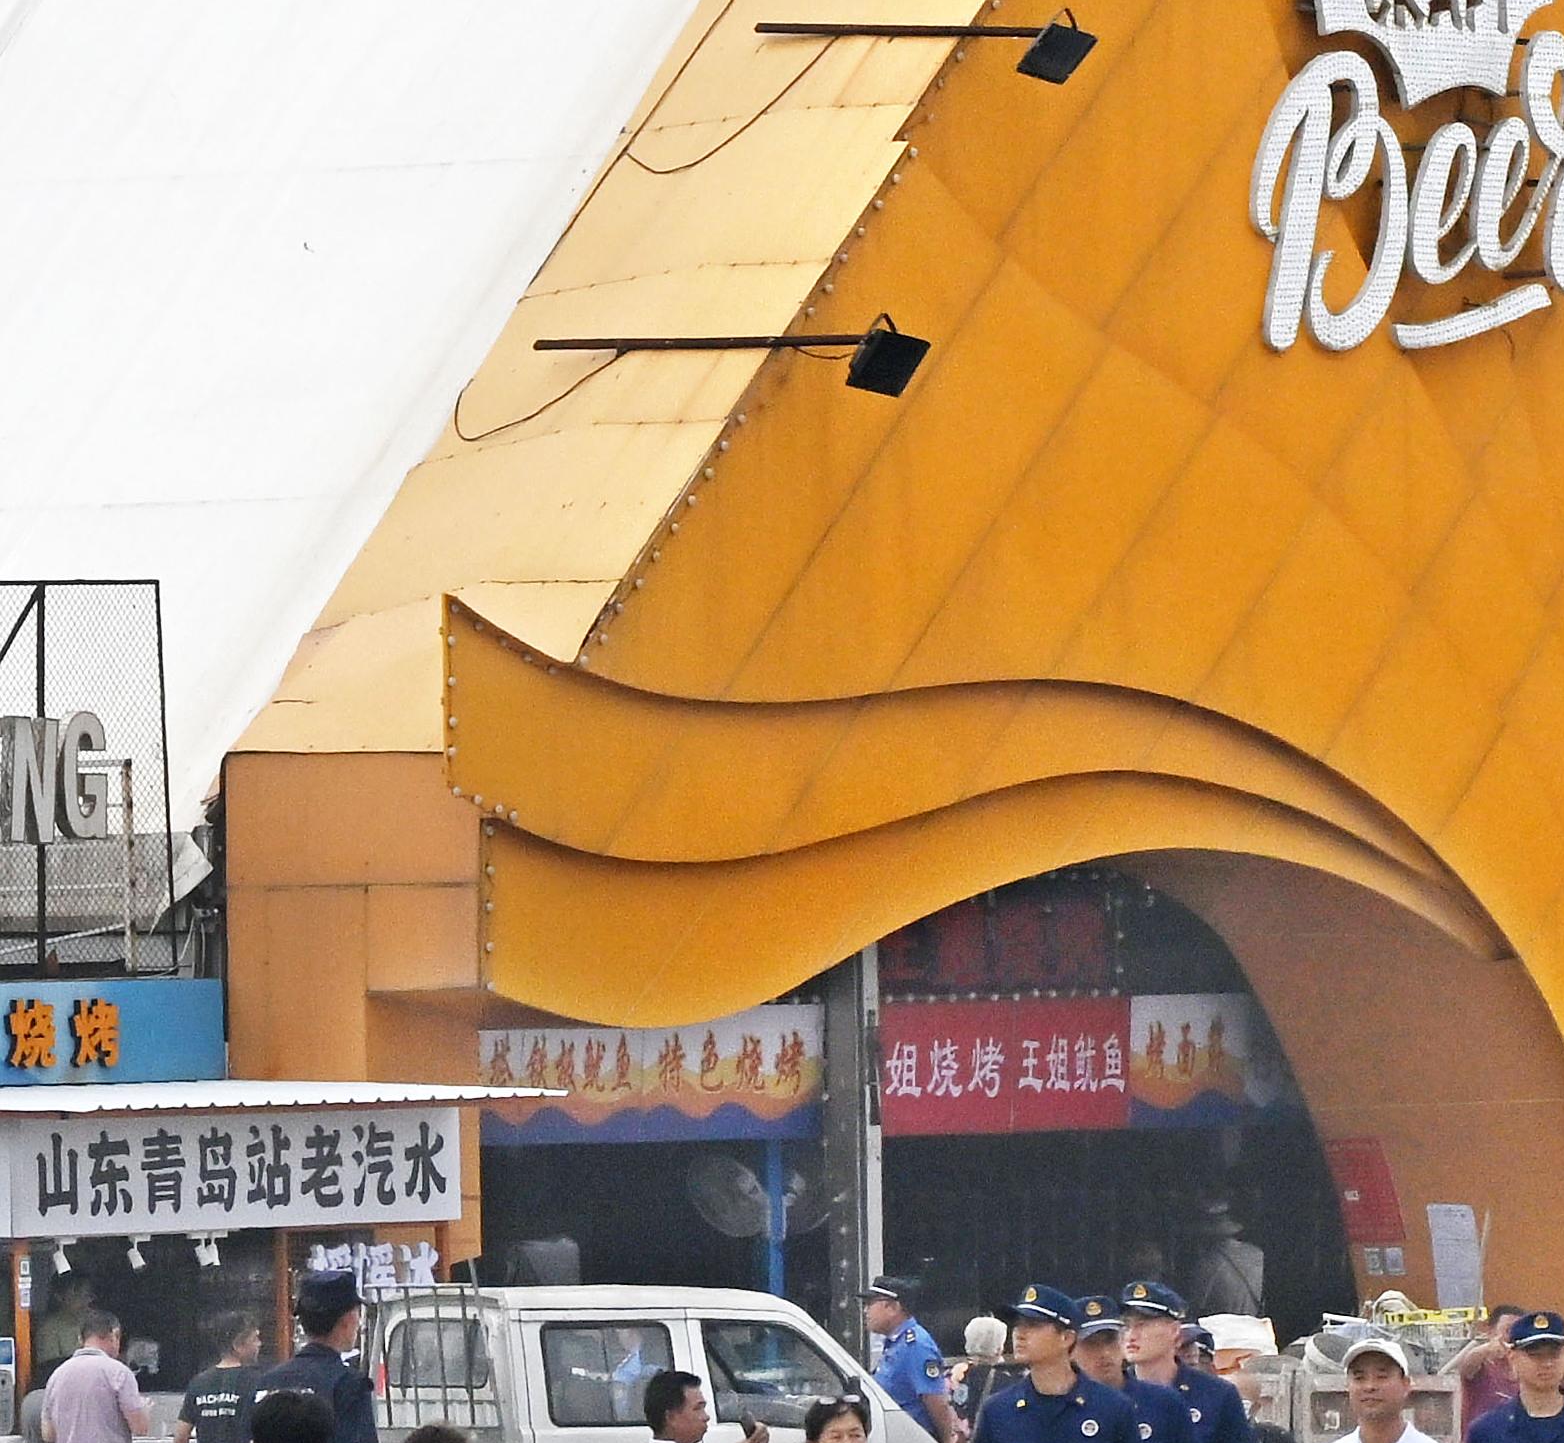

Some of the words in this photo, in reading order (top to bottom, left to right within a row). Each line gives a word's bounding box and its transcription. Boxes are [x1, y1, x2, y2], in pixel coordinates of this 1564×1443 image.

[6, 998, 121, 1070] 烧烤
[658, 1029, 804, 1095] 特色烧烤
[1018, 1032, 1126, 1094] 王姐鱿鱼
[36, 1121, 447, 1216] 山东青岛站老汽水
